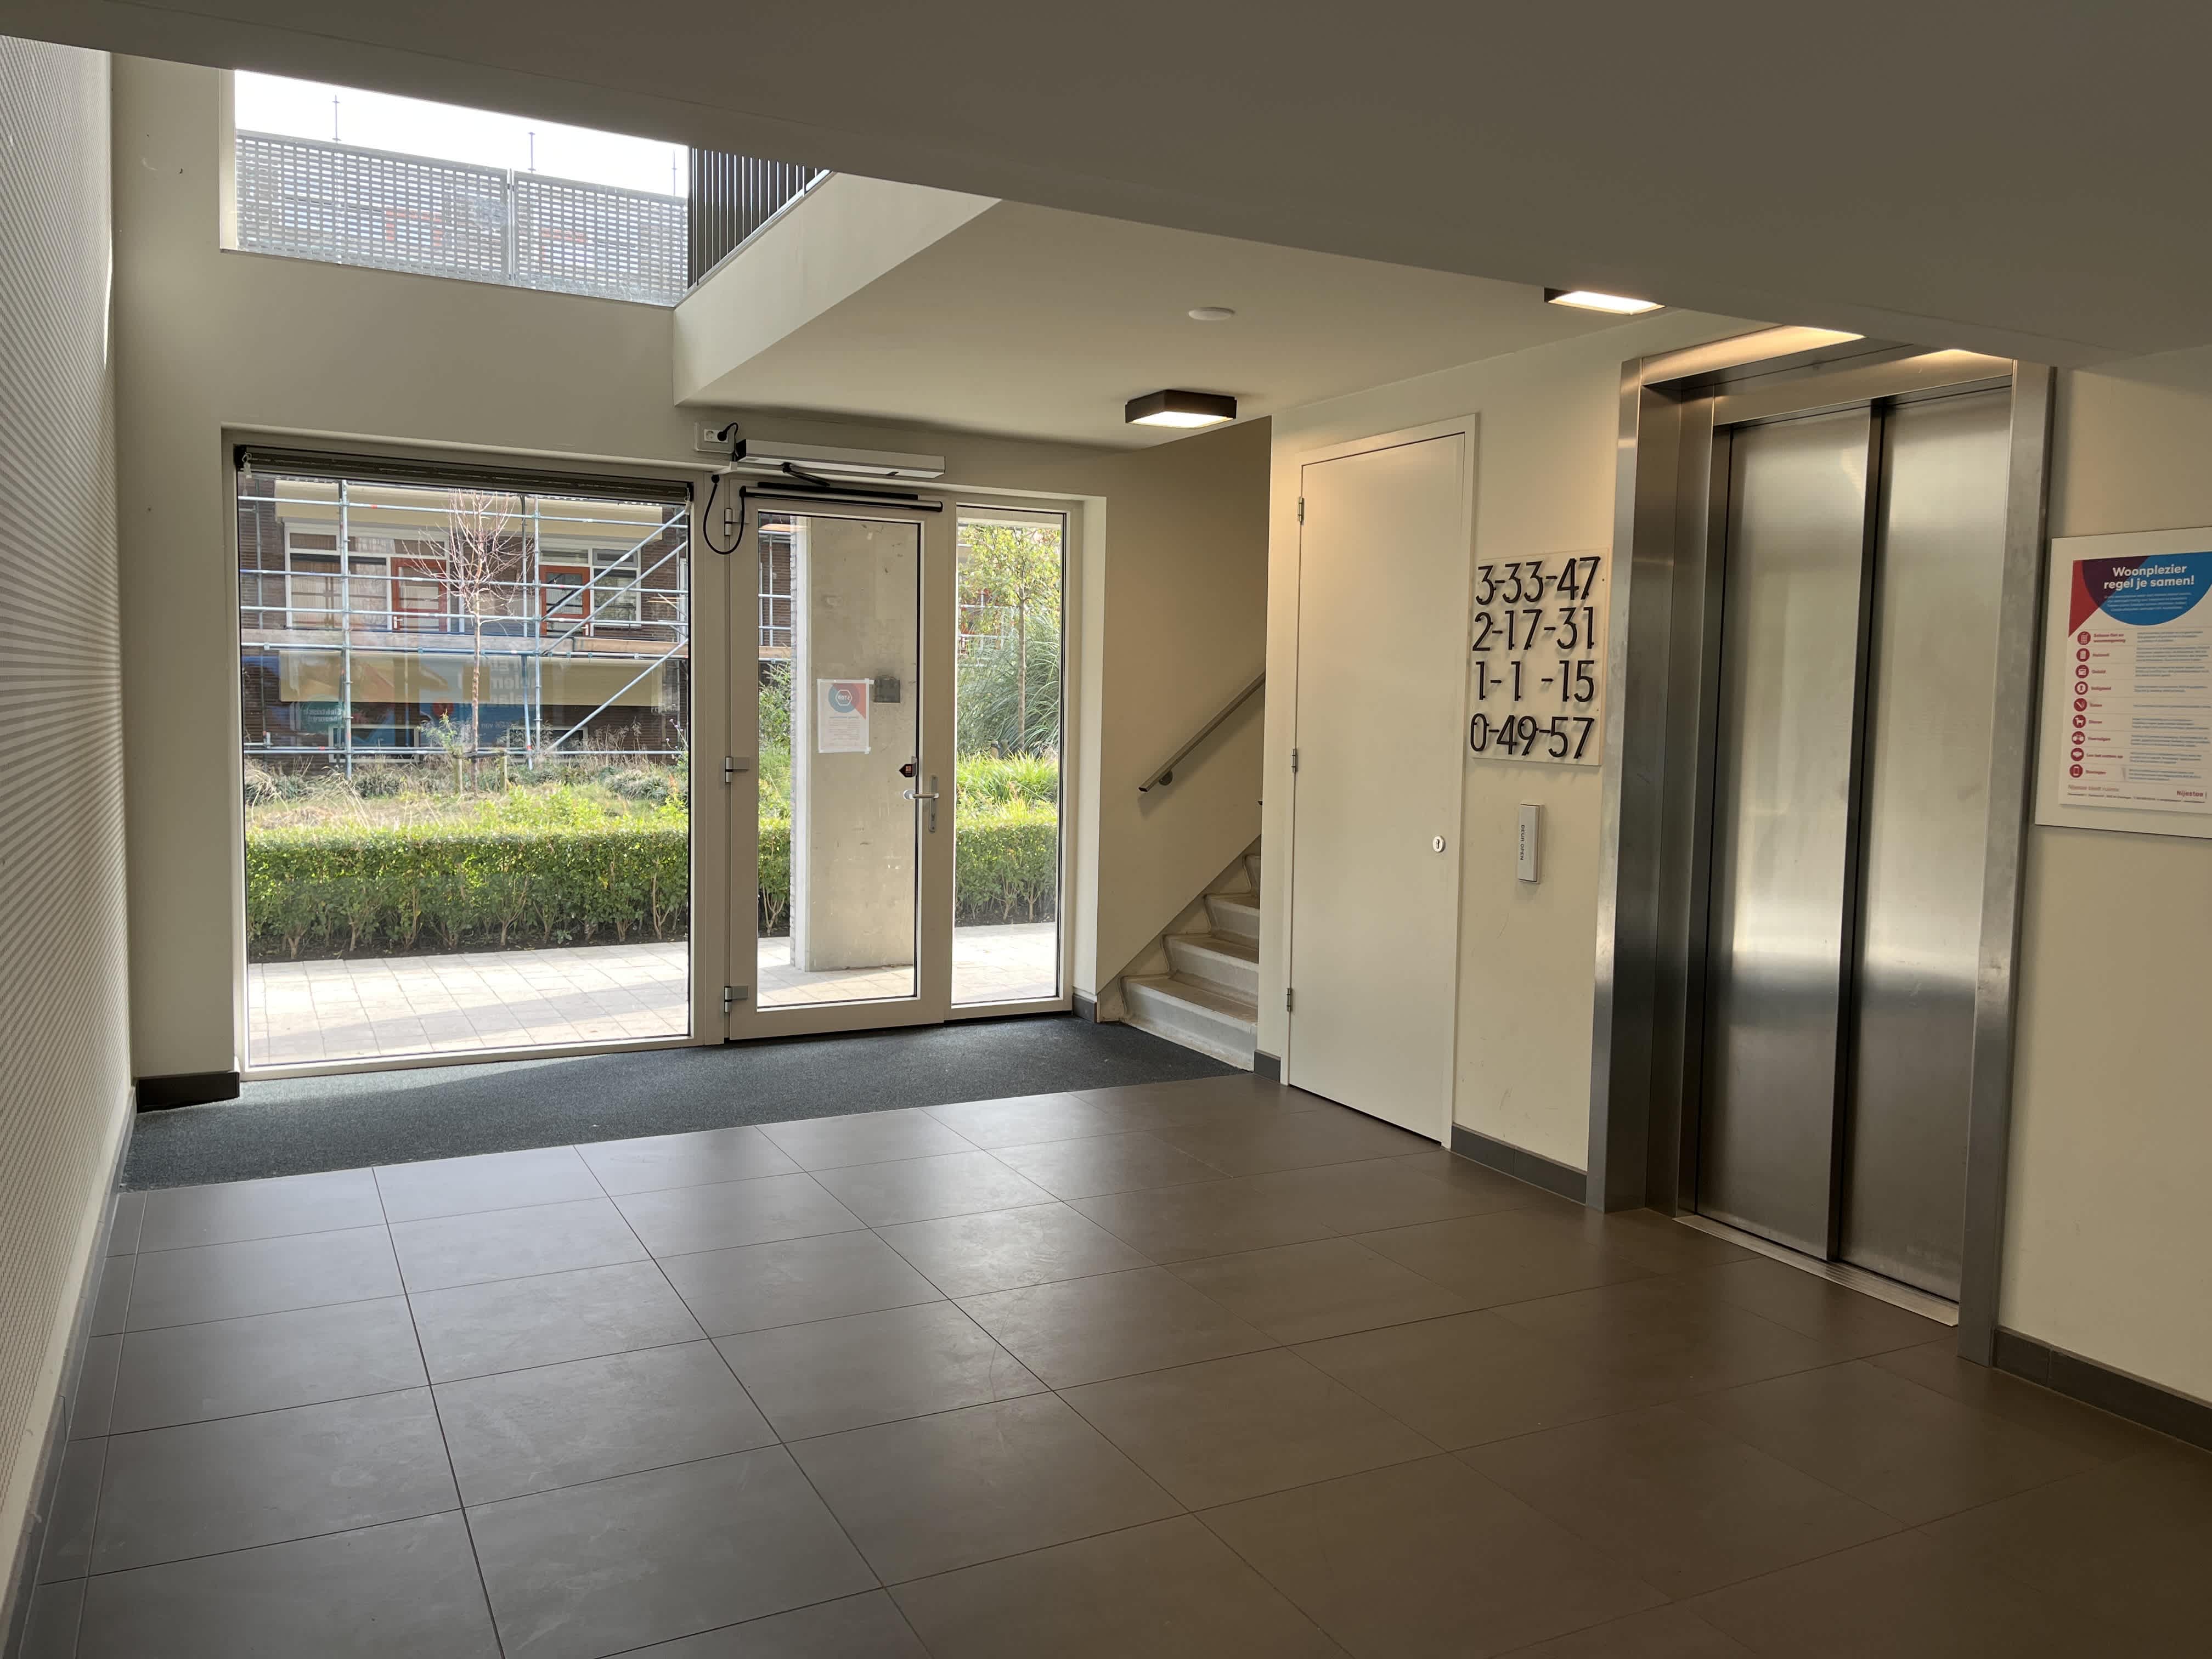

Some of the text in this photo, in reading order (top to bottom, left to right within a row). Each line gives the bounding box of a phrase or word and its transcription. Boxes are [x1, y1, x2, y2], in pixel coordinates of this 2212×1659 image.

[1476, 556, 1601, 605] 3-33-47
[2103, 574, 2195, 591] regel je samen!
[2112, 563, 2187, 577] Woonplezier
[1472, 606, 1594, 651] 2-17-31
[1470, 713, 1595, 759] 0-49-57
